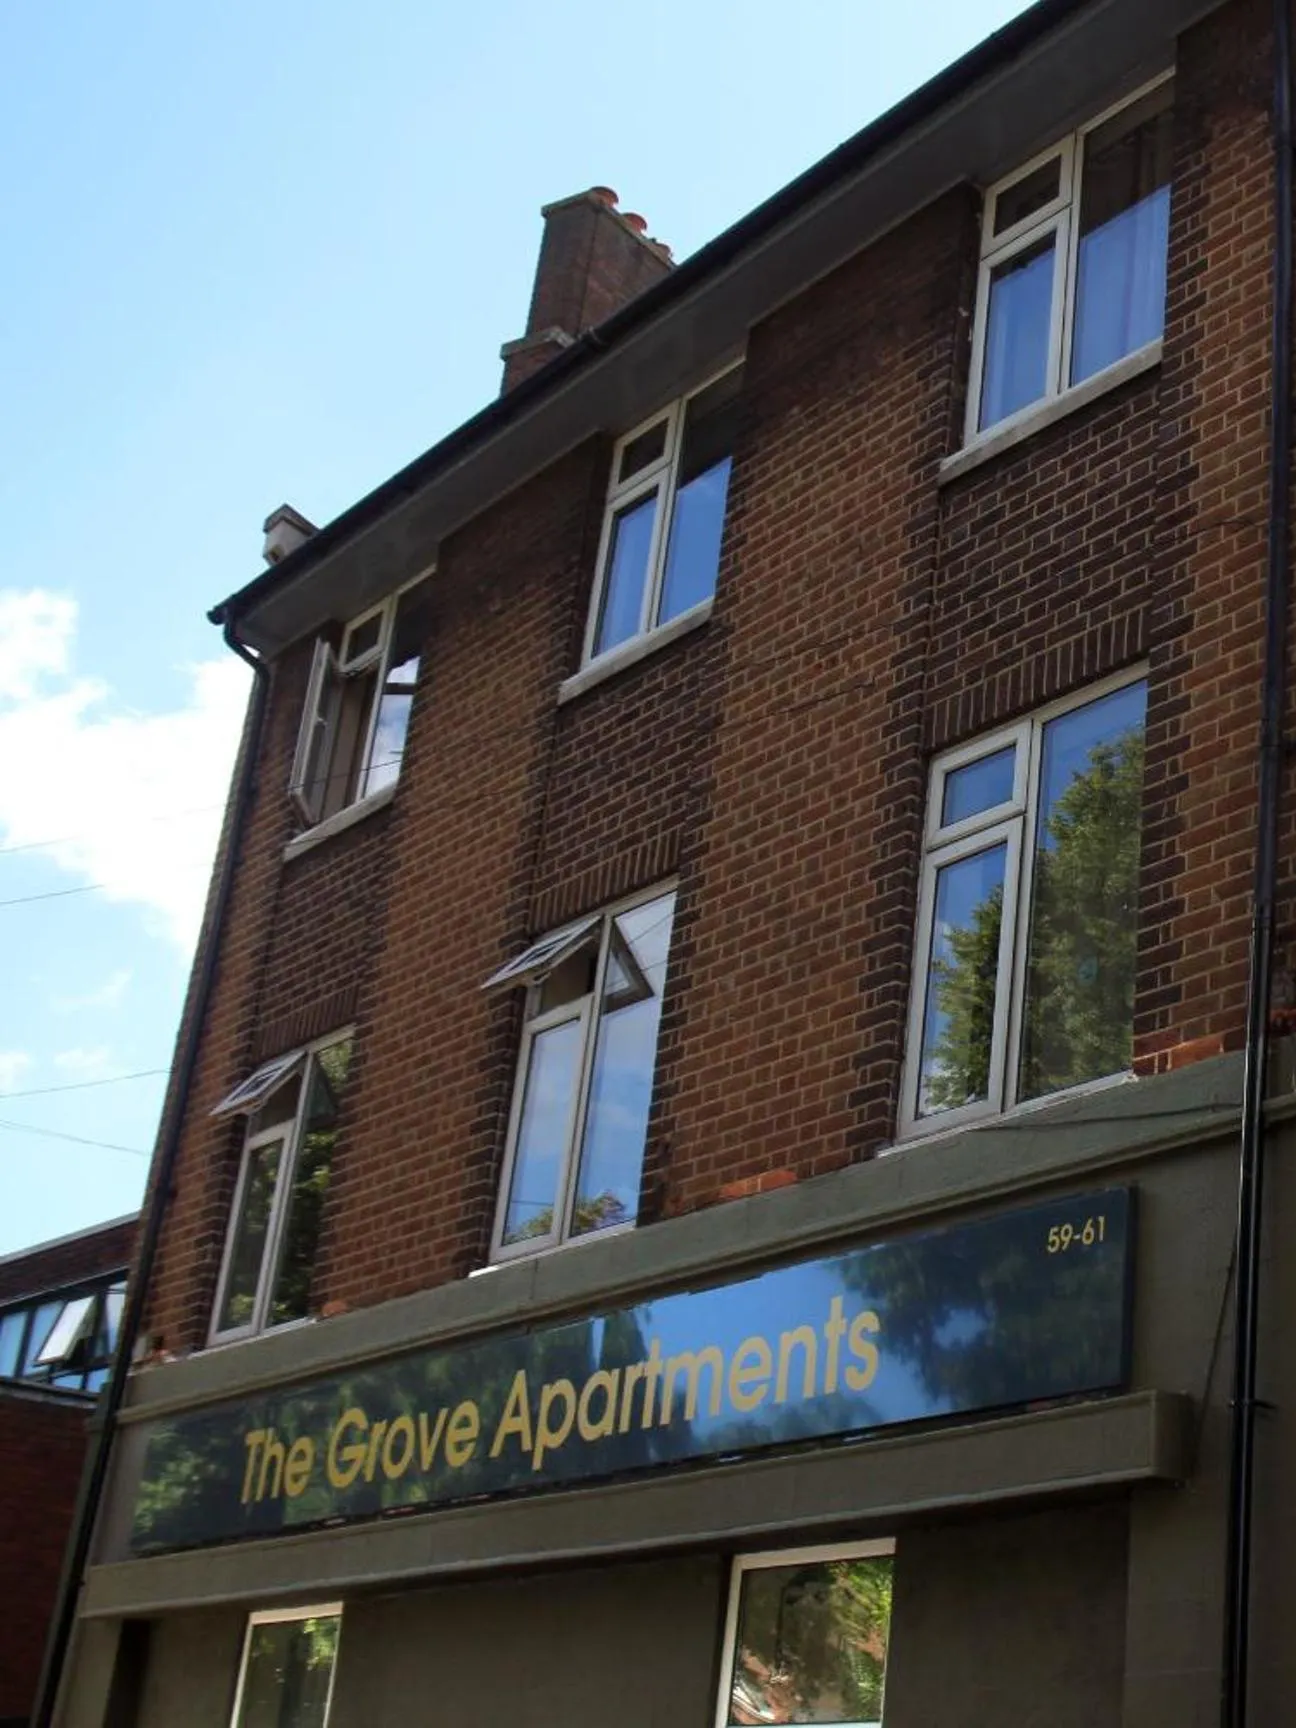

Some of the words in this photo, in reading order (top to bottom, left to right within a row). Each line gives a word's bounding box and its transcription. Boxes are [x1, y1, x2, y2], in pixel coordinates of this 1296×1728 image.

[1046, 1215, 1106, 1253] 59-61
[241, 1428, 314, 1505] The
[326, 1399, 480, 1489] Grove
[490, 1295, 880, 1471] Apartments
